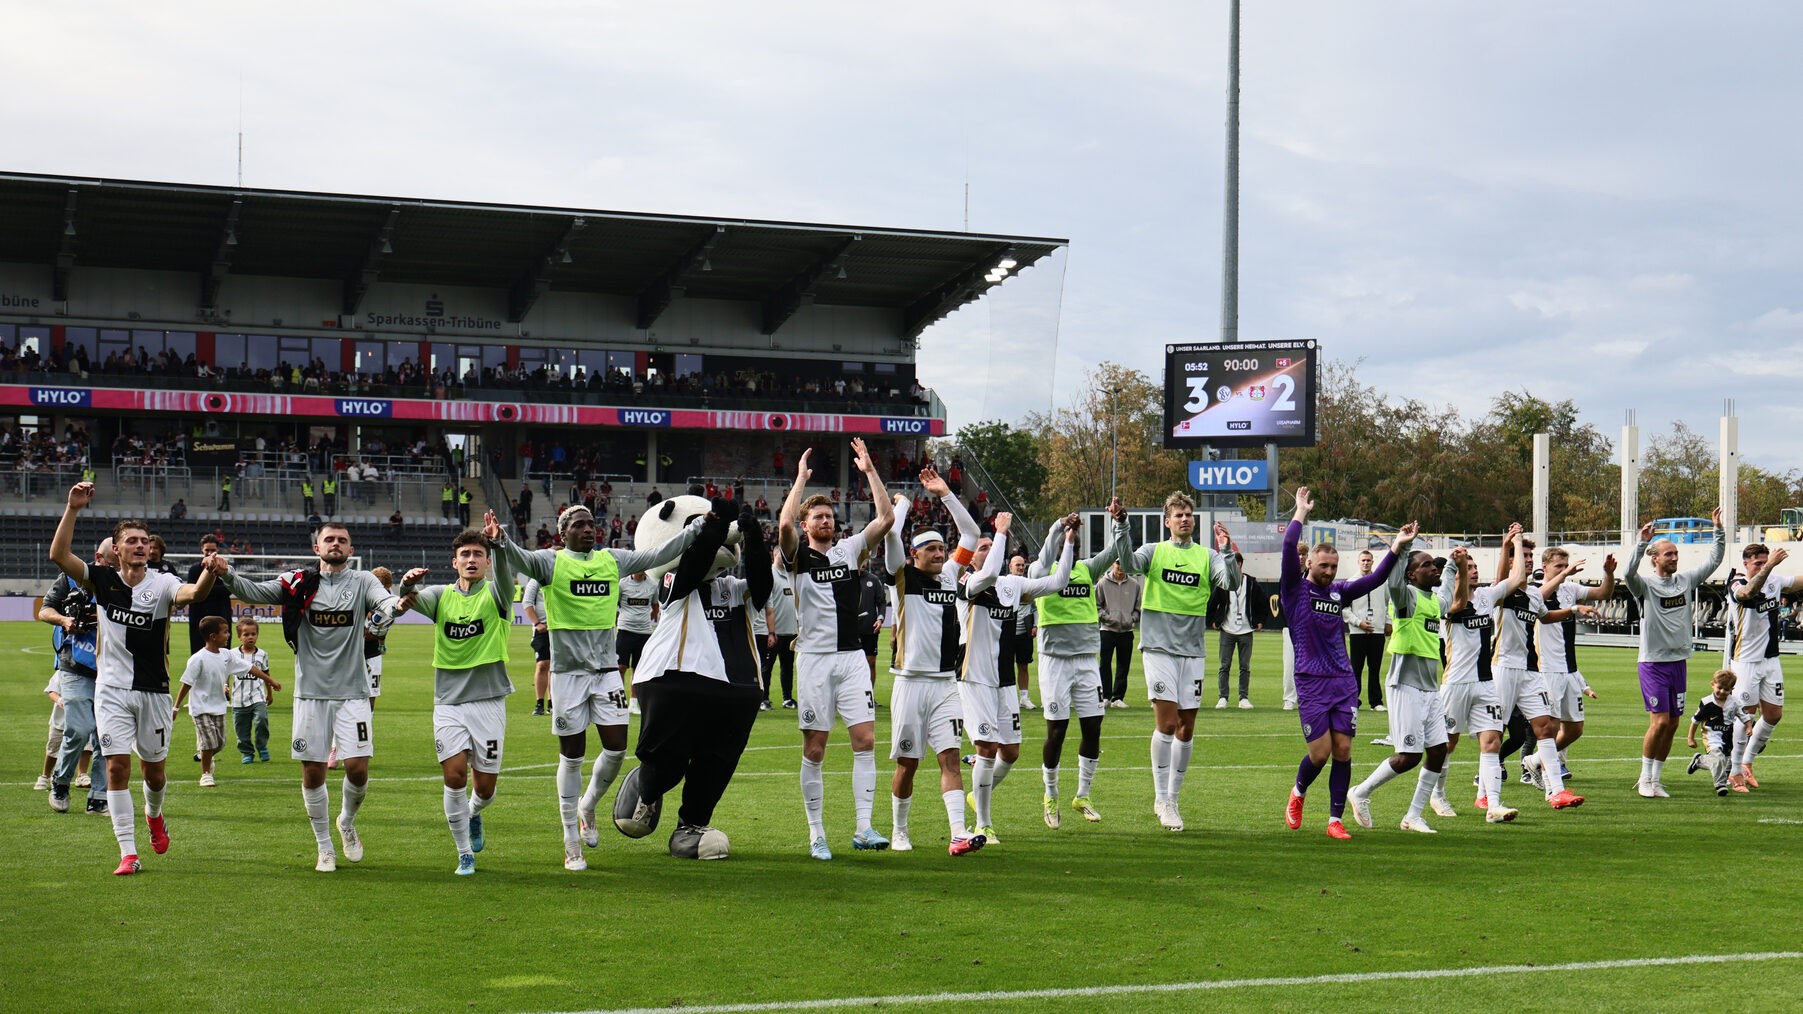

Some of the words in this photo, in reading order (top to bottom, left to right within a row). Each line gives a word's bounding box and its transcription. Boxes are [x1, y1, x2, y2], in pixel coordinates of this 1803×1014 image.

[367, 312, 501, 330] Sparkassen-Tribüne
[1185, 363, 1208, 371] 05:52
[1224, 359, 1258, 371] 90:00
[37, 390, 80, 403] HYLO
[1184, 377, 1209, 413] 3
[1270, 374, 1295, 411] 2
[342, 402, 382, 414] HYLO
[624, 411, 661, 423] HYLO
[887, 420, 921, 433] HYLO
[816, 570, 844, 581] HYLO
[1166, 572, 1194, 584] HYLO
[576, 584, 605, 594] HYLO
[1063, 586, 1087, 595] HYLO
[928, 592, 955, 602] HYLO
[231, 605, 275, 617] lent
[1315, 601, 1339, 614] HYLO
[111, 609, 146, 626] HYLO
[314, 614, 347, 624] HYLO
[704, 609, 724, 619] YLO
[1518, 610, 1536, 622] HYLO
[1468, 618, 1489, 628] HYLO
[449, 624, 477, 637] HYLO
[608, 690, 628, 709] 42
[155, 728, 164, 747] 7
[357, 722, 368, 742] 8
[487, 740, 498, 760] 2
